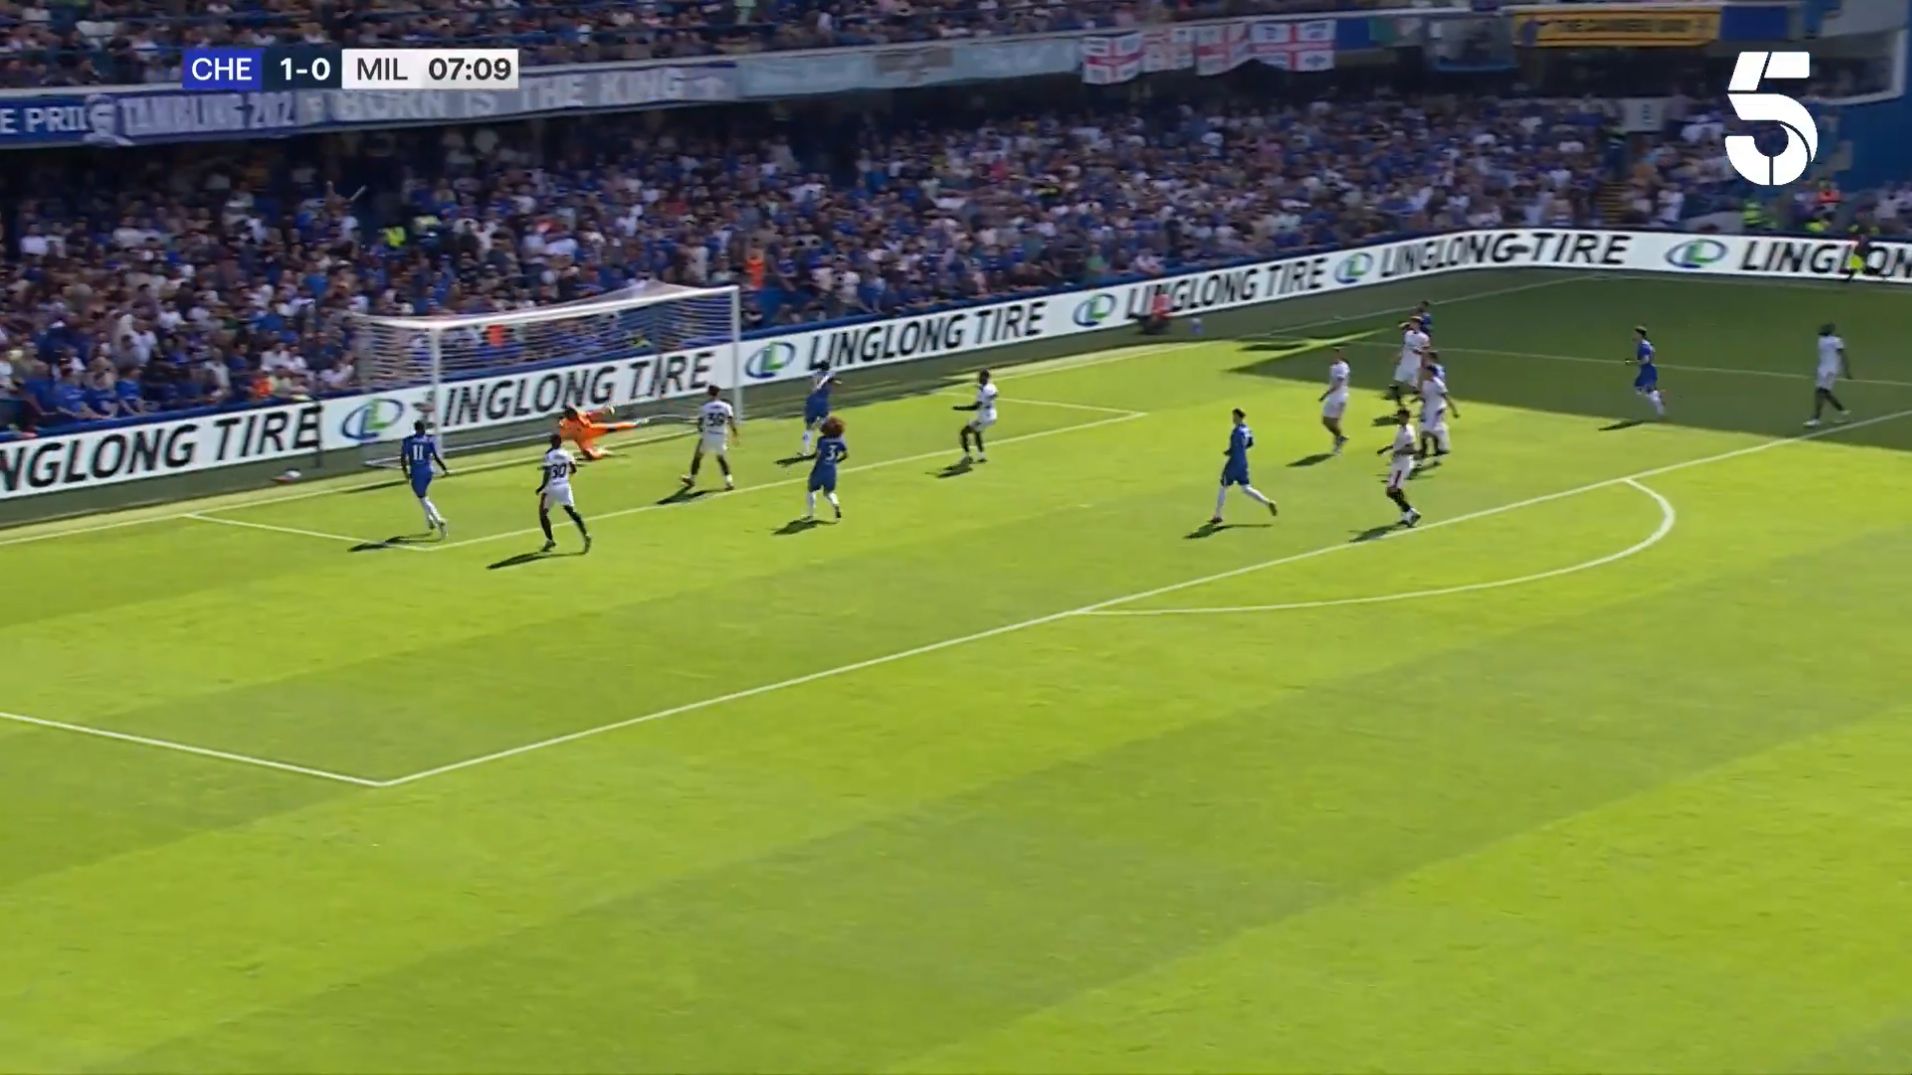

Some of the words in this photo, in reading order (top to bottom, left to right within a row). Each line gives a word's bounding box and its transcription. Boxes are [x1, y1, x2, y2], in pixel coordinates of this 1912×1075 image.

[1266, 256, 1328, 298] TIRE
[1381, 233, 1519, 277] LINGLONG
[1531, 232, 1632, 264] TIRE
[808, 314, 965, 371] LINGLONG
[974, 301, 1048, 345] TIRE
[630, 351, 715, 409] TIRE
[216, 402, 324, 462] TIRE
[412, 444, 424, 461] 11
[551, 463, 567, 479] 30
